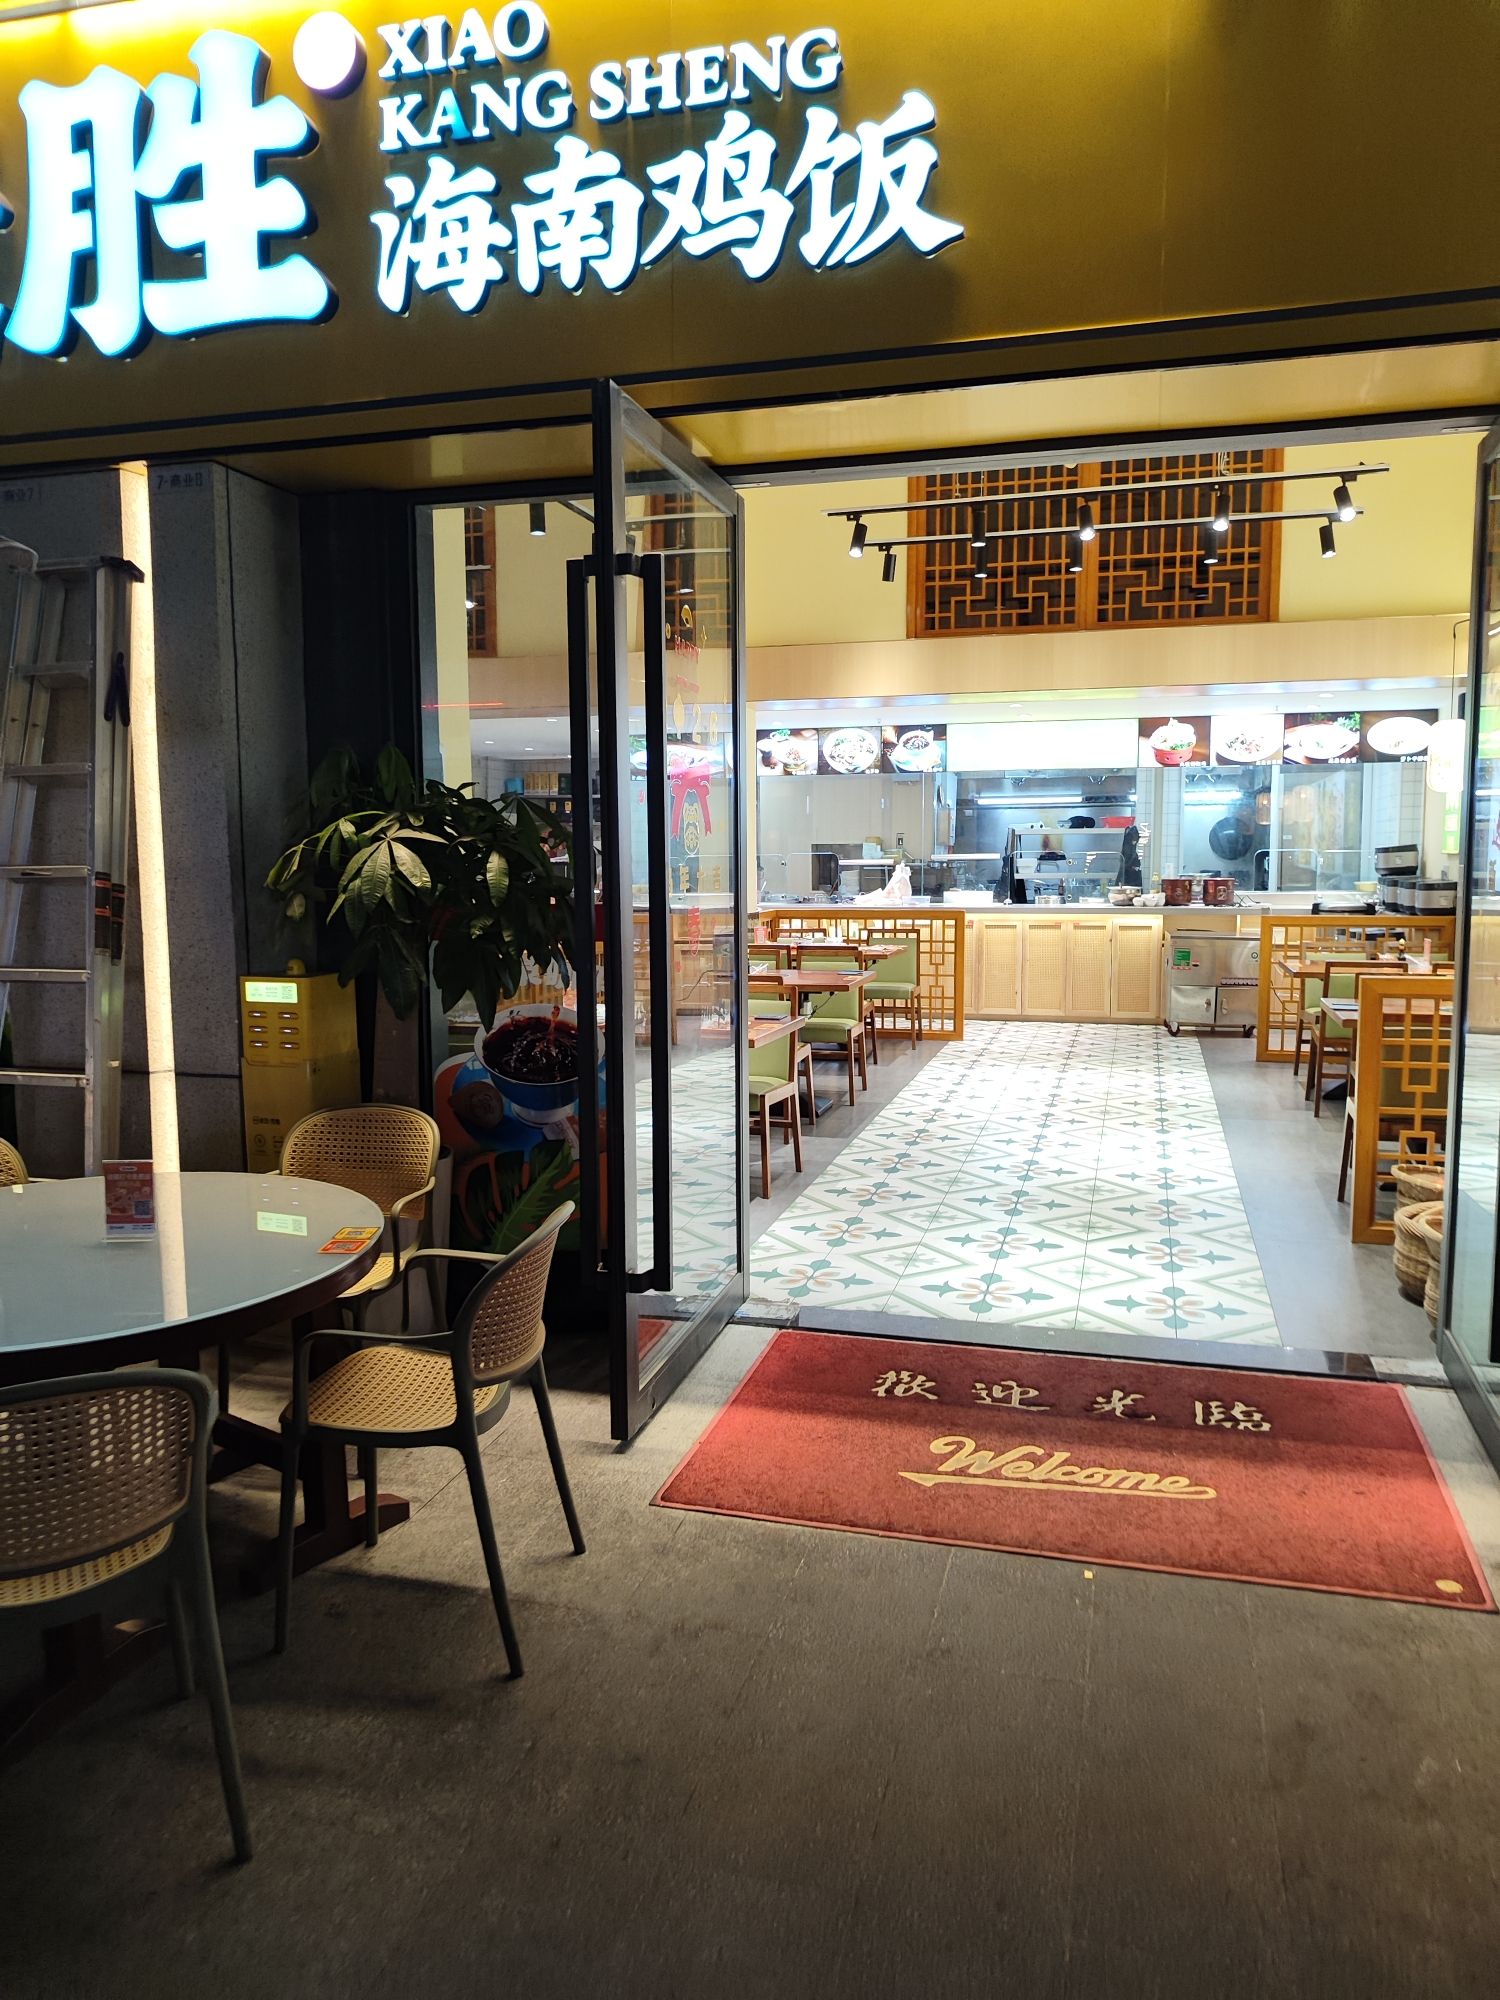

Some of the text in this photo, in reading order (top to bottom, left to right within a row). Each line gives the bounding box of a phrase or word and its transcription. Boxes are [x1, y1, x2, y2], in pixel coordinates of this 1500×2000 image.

[377, 0, 548, 79] XIAO
[379, 28, 843, 152] KANG SHENG
[4, 31, 331, 356] 胜
[370, 90, 965, 314] 海南鸡饭
[928, 1434, 1218, 1497] Welcome
